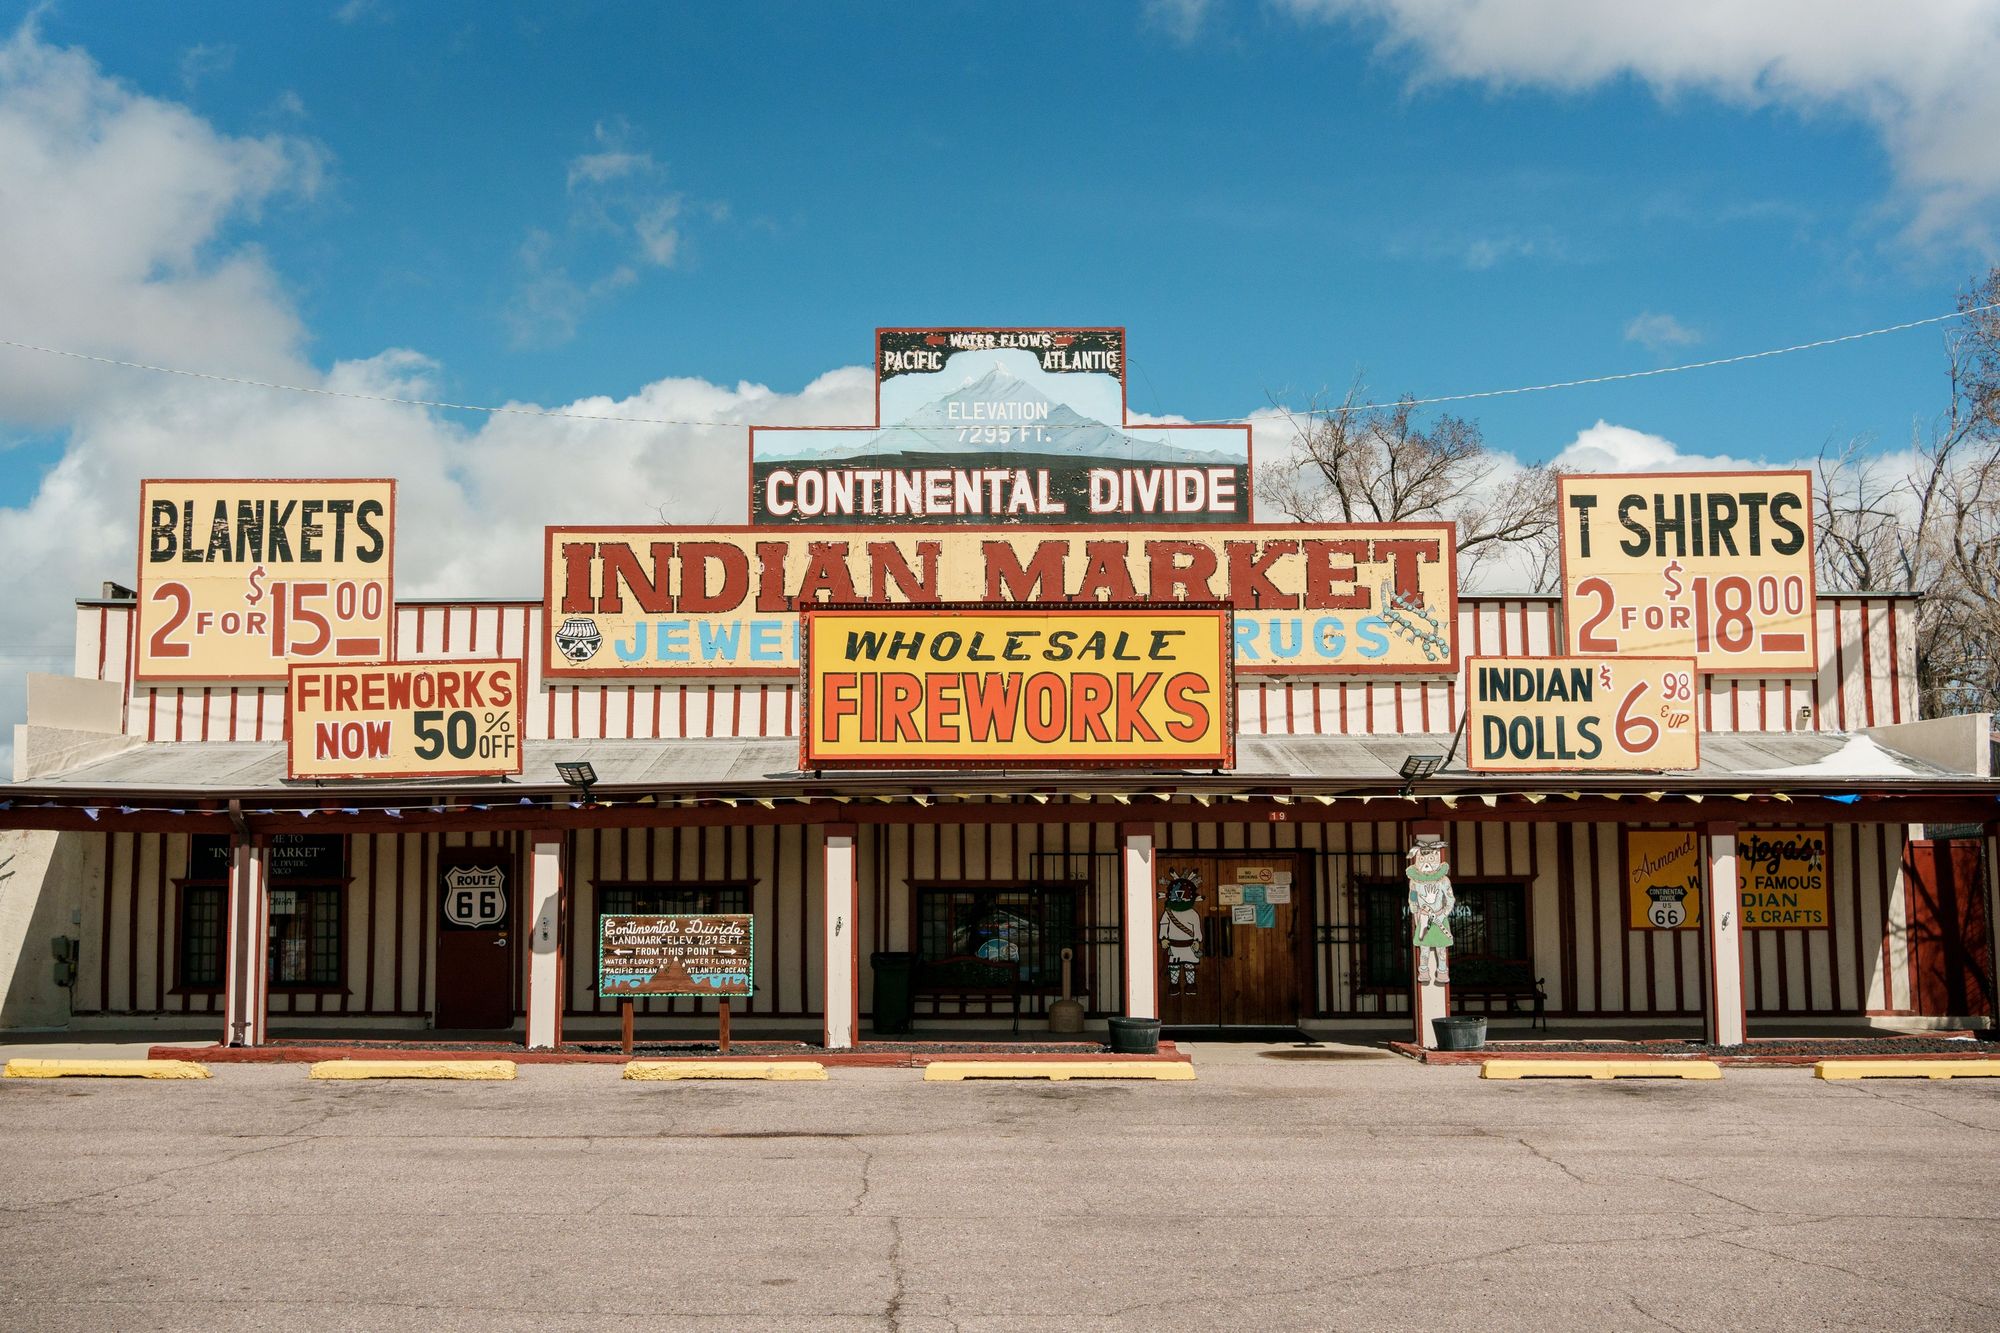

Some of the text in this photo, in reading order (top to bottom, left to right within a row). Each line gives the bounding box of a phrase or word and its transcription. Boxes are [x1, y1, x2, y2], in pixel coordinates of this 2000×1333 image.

[950, 334, 1051, 347] WATER FLOWS
[885, 351, 943, 370] PACIFIC
[1042, 351, 1117, 369] ATLANTIC
[948, 402, 1048, 420] ELEVATION
[957, 425, 1052, 443] 7295 FT.
[766, 468, 1238, 515] CONTINENTAL DIVIDE
[149, 499, 384, 564] BLANKETS
[1570, 492, 1805, 558] T SHIRTS
[561, 538, 1440, 614] INDIAN MARKET
[149, 581, 191, 658] 2
[197, 611, 267, 636] FOR
[1575, 577, 1618, 652] 2
[1621, 605, 1690, 630] FOR
[614, 620, 800, 662] JEWE
[844, 630, 1186, 662] WHOLESALE
[298, 671, 512, 712] FIREWORKS
[1478, 667, 1593, 702] INDIAN
[821, 671, 1210, 744] FIREWORKS
[316, 721, 391, 759] NOW
[479, 735, 516, 759] OFF
[1483, 715, 1602, 760] DOLLS
[1668, 714, 1690, 728] UP
[287, 834, 304, 843] TO
[1738, 834, 1813, 875] rtega's
[1632, 833, 1695, 883] Armand
[457, 875, 496, 886] ROUTE
[1755, 876, 1822, 889] FAMOUS
[456, 891, 496, 918] 66
[1741, 893, 1798, 907] DIAN
[605, 918, 745, 936] Continental Divide
[1655, 910, 1678, 924] 66
[1745, 911, 1822, 923] & CRAFTS
[635, 947, 717, 956] FROM THIS POINT
